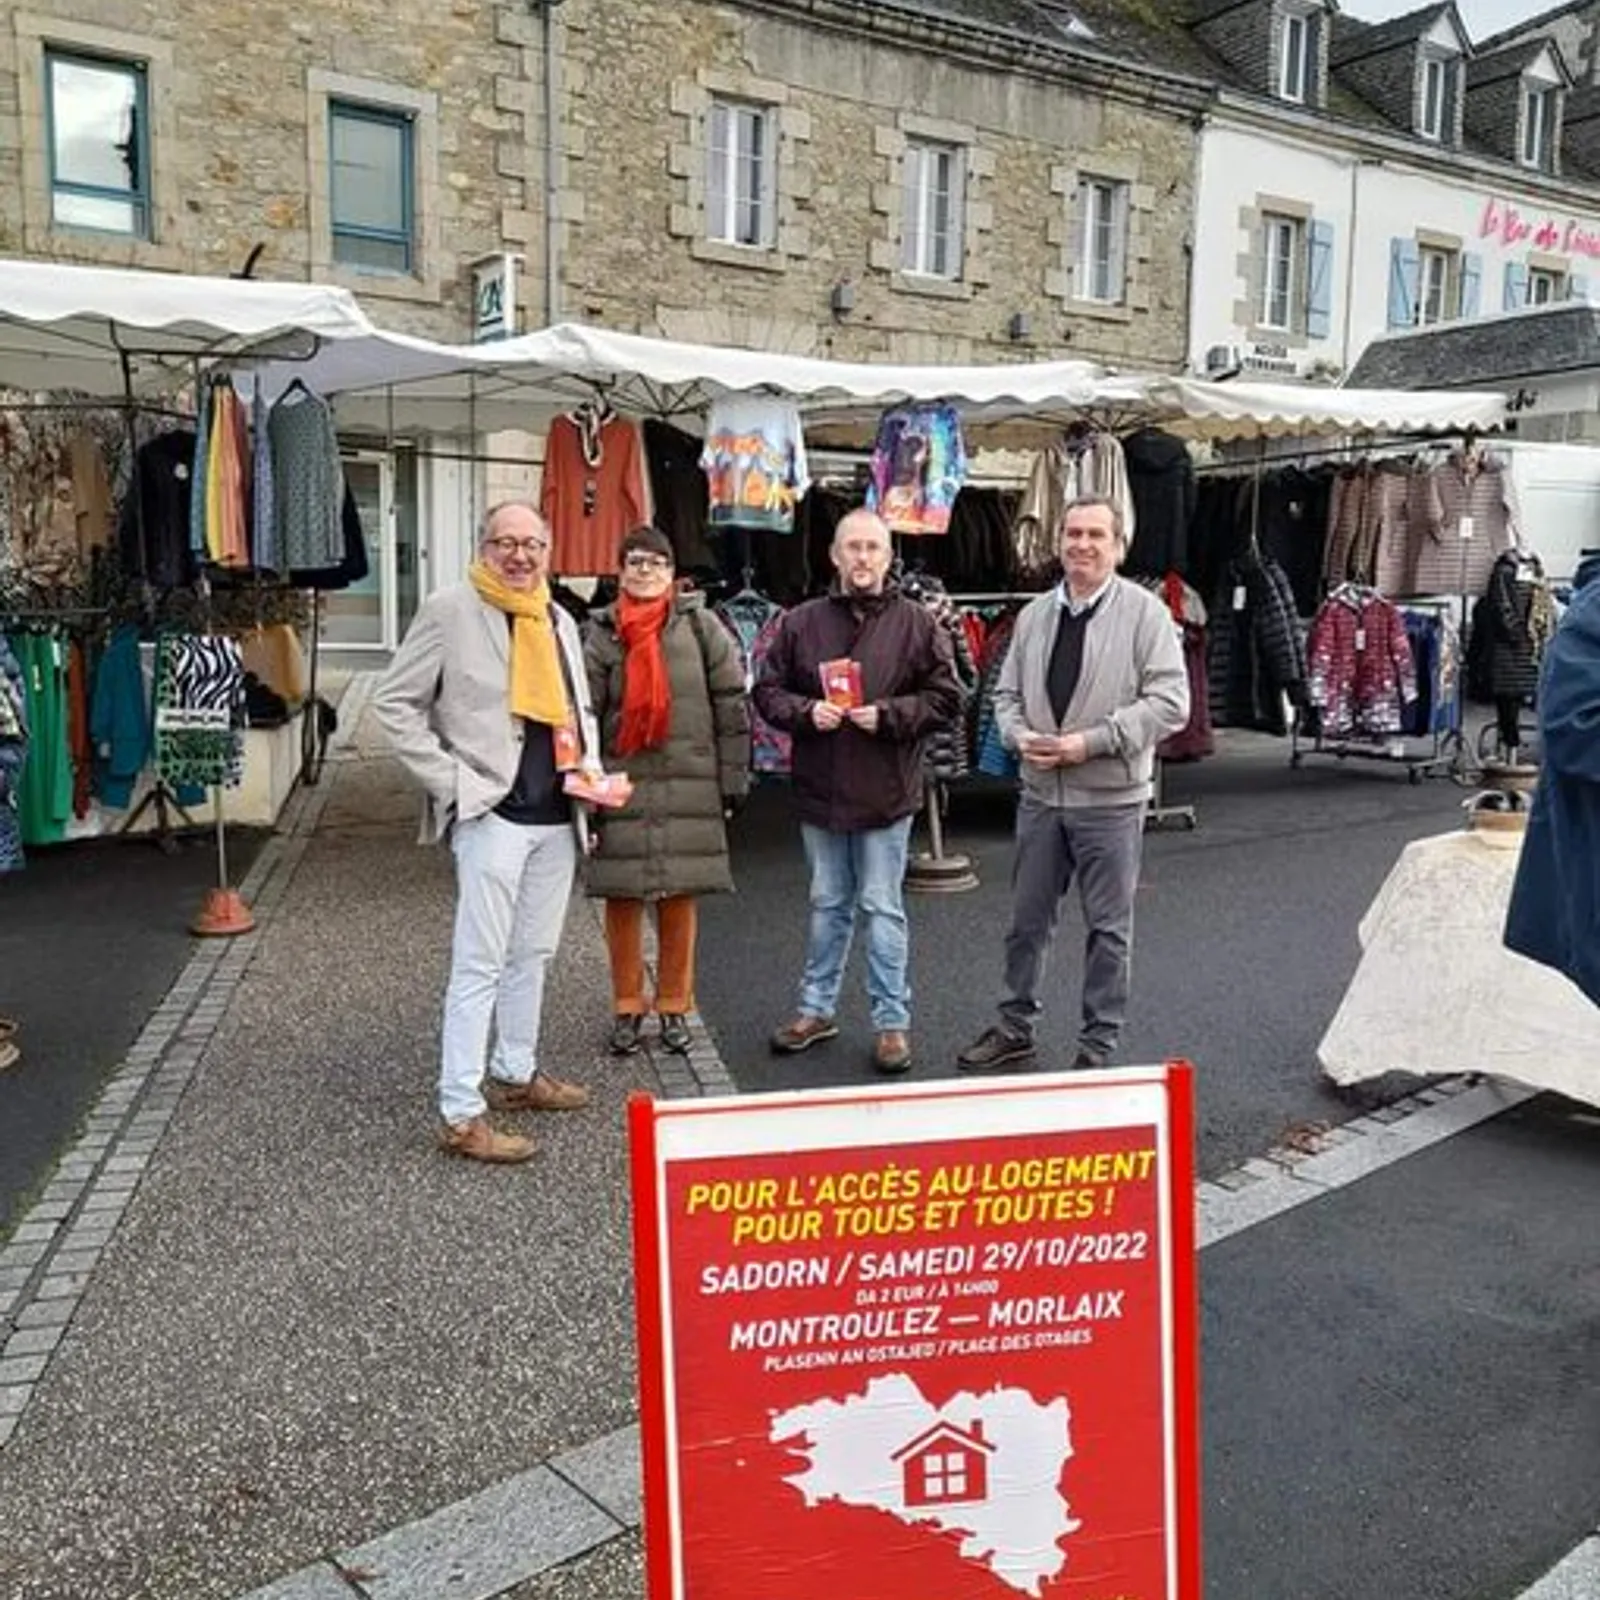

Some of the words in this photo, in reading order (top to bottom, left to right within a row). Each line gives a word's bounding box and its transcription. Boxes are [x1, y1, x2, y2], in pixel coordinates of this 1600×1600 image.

[686, 1179, 778, 1215] POUR
[786, 1163, 921, 1207] L'ACCÈS
[928, 1164, 974, 1198] AU
[981, 1150, 1156, 1193] LOGEMENT
[733, 1210, 823, 1247] POUR
[833, 1203, 916, 1237] TOUS
[923, 1200, 965, 1231] ET
[973, 1188, 1095, 1226] TOUTES
[1102, 1187, 1115, 1216] !
[700, 1256, 830, 1298] SADORN
[834, 1251, 853, 1288] /
[858, 1245, 975, 1281] SAMEDI
[982, 1231, 1148, 1272] 29/10/2022
[893, 1285, 925, 1303] EUR
[730, 1305, 942, 1350] MONTROULEZ
[987, 1289, 1125, 1329] MORLAIX
[840, 1348, 865, 1365] AN
[947, 1335, 998, 1356] PLACE
[1000, 1332, 1031, 1351] DES
[1034, 1327, 1094, 1348] OTAGES
